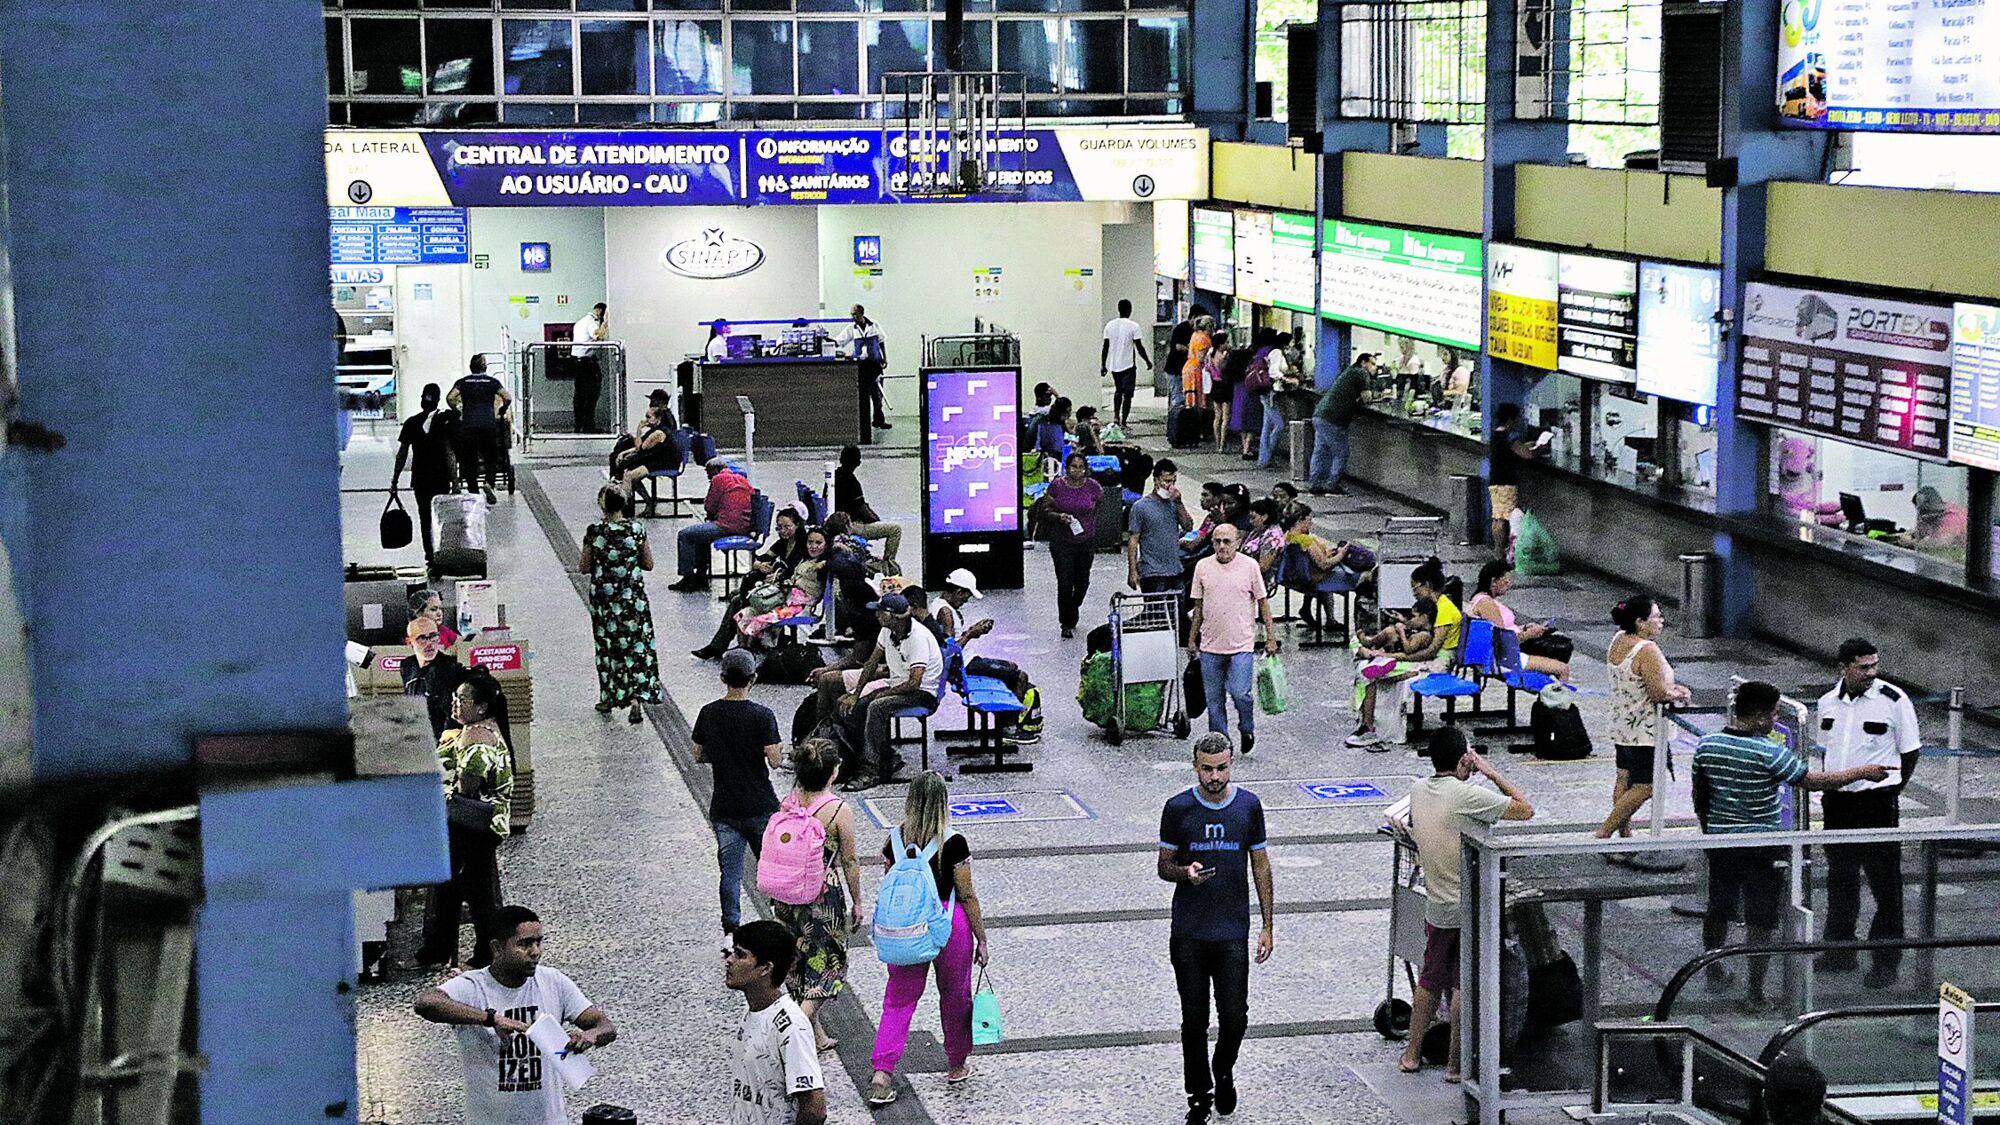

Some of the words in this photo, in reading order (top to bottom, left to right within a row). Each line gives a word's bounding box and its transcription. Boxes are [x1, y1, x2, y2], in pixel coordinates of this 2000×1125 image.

[352, 142, 420, 154] LATERAL
[778, 137, 870, 156] INFORMAÇÃO
[1079, 139, 1133, 150] GUARDA
[1138, 138, 1197, 150] VOLUMES
[454, 144, 547, 165] CENTRAL
[549, 144, 578, 165] DE
[580, 144, 730, 165] ATENDIMENTO
[500, 175, 534, 195] AO
[536, 170, 630, 195] USUÁRIO
[645, 174, 689, 194] CAU
[790, 172, 870, 190] SANITÁRIOS
[1847, 307, 1931, 336] PORTEX
[1190, 841, 1213, 851] Real
[1215, 841, 1239, 851] Maia
[499, 1058, 542, 1083] IZED
